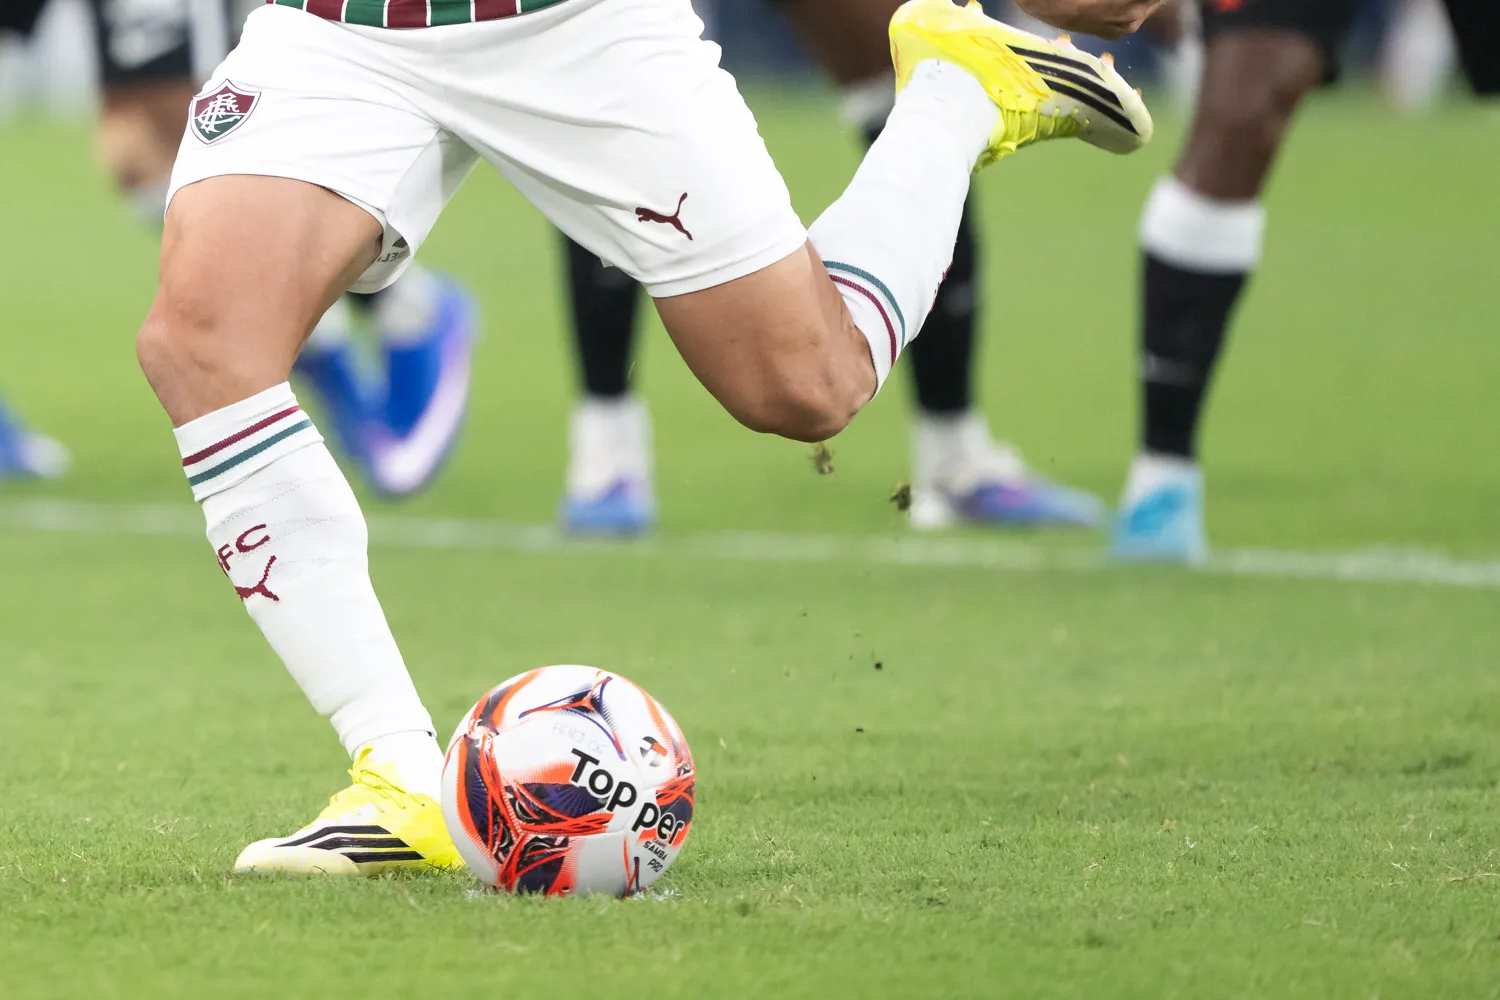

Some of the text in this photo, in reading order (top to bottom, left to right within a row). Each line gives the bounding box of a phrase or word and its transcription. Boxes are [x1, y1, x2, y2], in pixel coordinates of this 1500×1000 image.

[217, 523, 271, 578] FC
[643, 841, 668, 861] SAMBA
[647, 858, 663, 872] PRO
